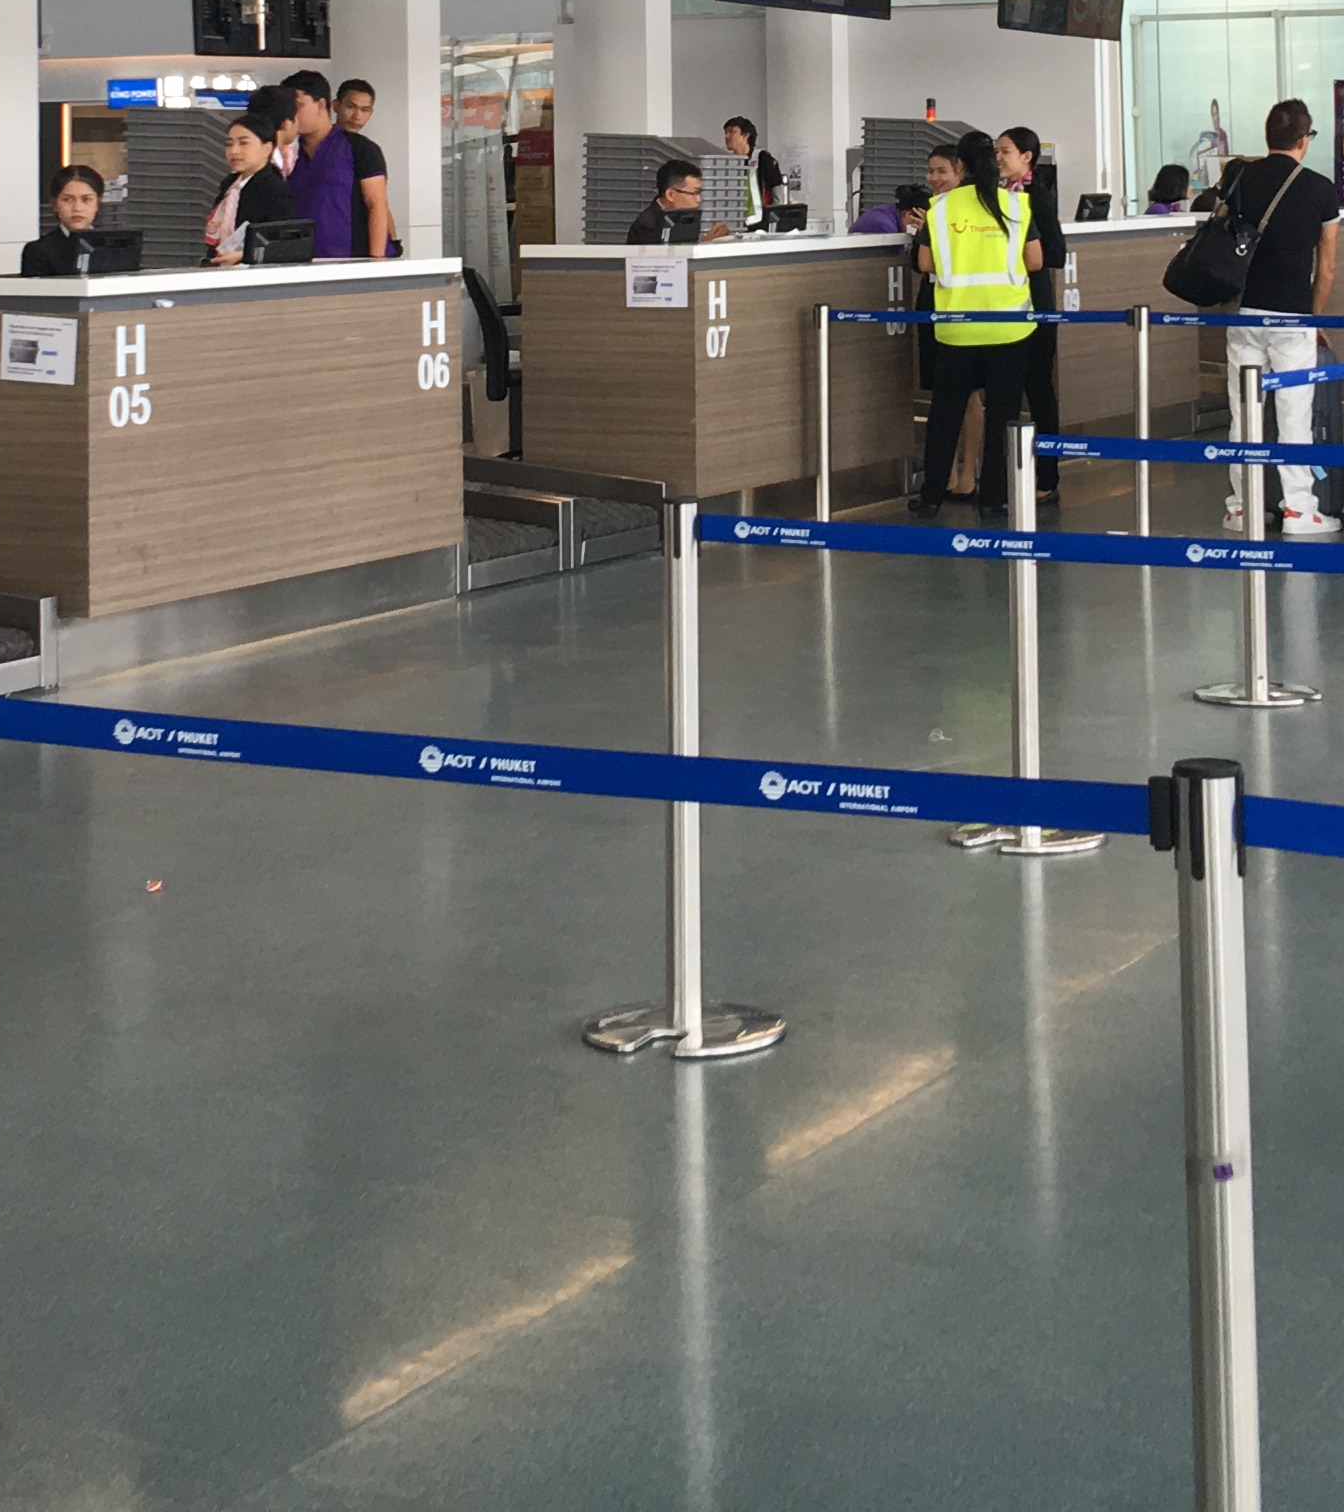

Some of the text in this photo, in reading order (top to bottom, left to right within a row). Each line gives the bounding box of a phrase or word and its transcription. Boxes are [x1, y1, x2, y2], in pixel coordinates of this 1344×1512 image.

[888, 266, 903, 301] H
[1064, 252, 1077, 284] H
[709, 280, 727, 320] H
[422, 300, 446, 346] H
[116, 324, 146, 377] H
[707, 325, 731, 358] 07
[417, 352, 450, 390] 06
[109, 383, 152, 427] 05
[968, 539, 991, 548] AOT
[137, 727, 218, 745] AOT PHUKET
[444, 754, 536, 772] AOT PHUKET
[787, 780, 890, 798] AOT PHUKET
